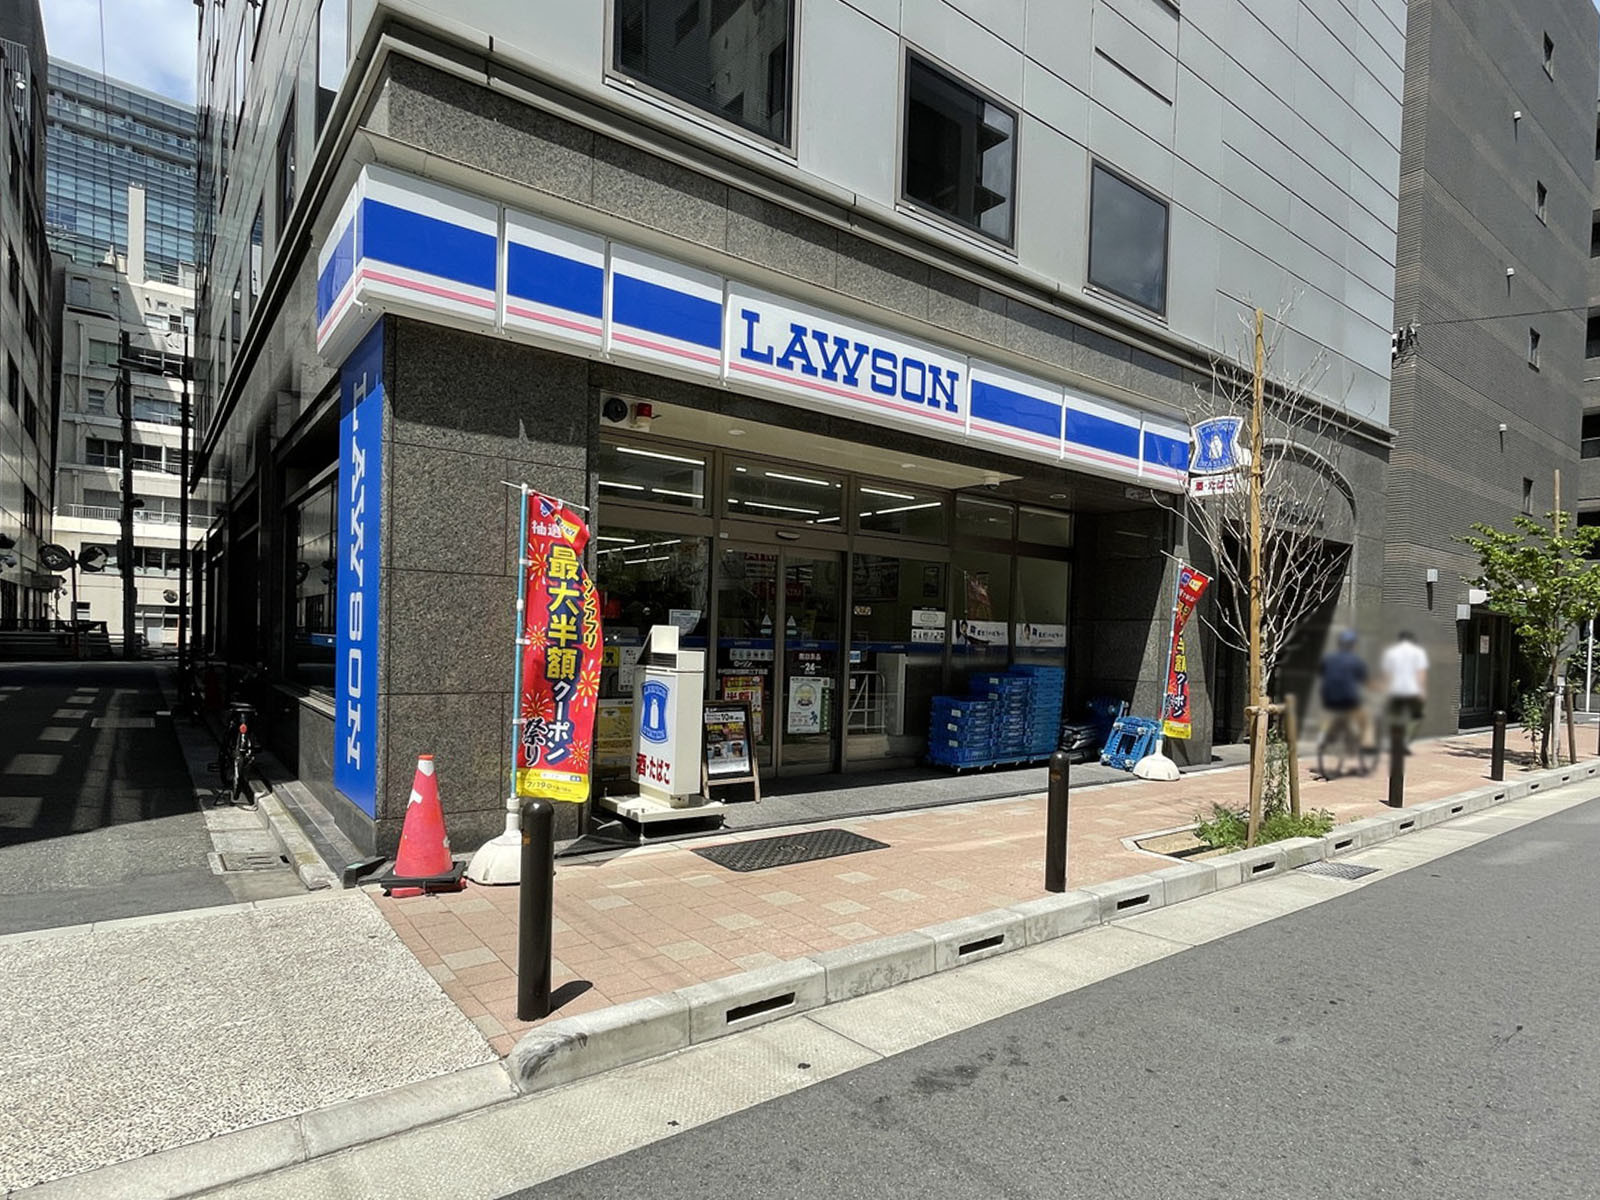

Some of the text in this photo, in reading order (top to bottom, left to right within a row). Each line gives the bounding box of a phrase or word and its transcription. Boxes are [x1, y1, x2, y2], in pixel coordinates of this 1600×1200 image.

[741, 308, 959, 413] LAWSON
[346, 371, 368, 771] LAWSON
[635, 752, 671, 786] 酒・たばこ
